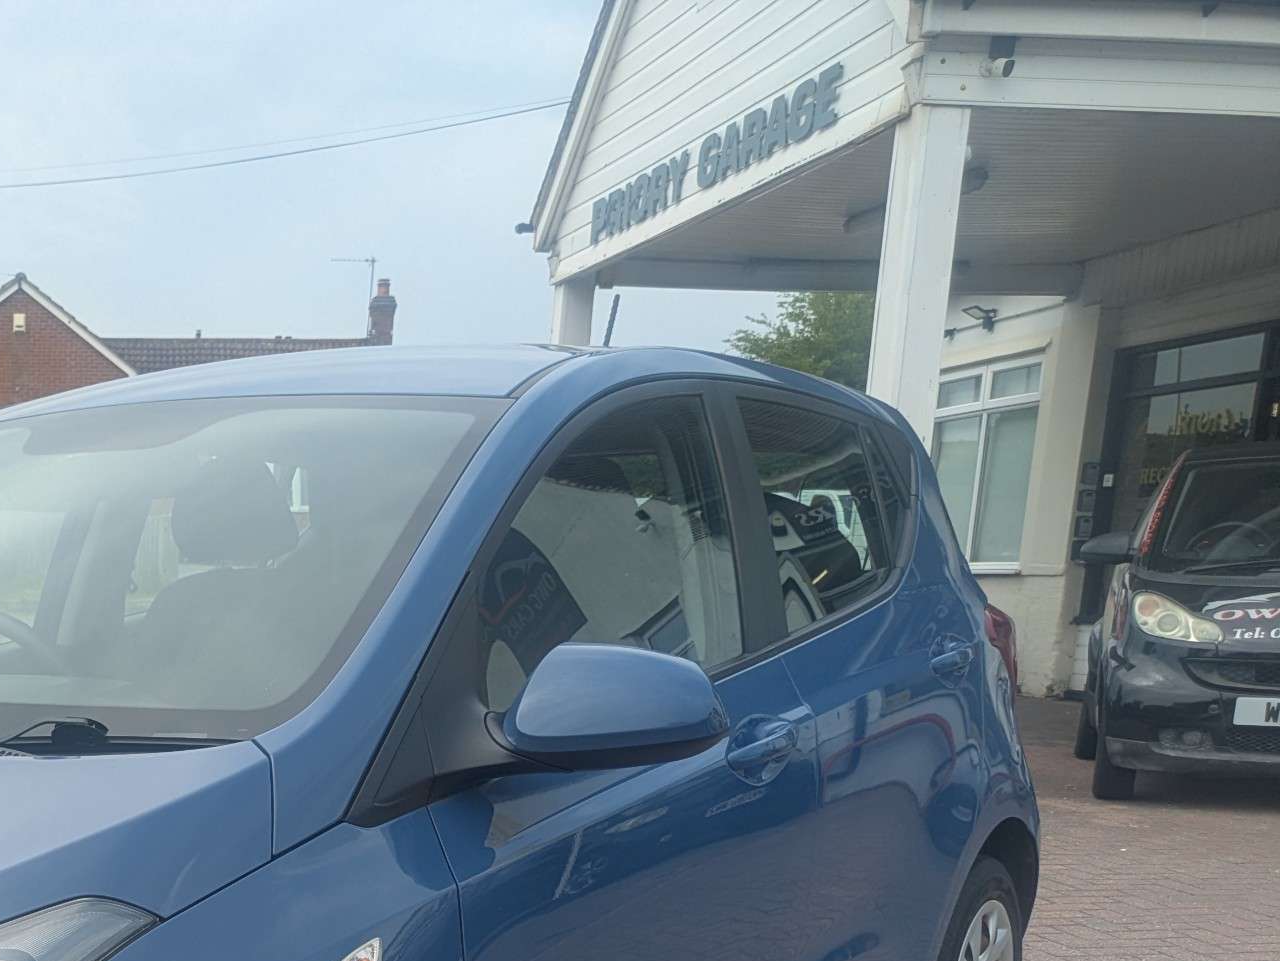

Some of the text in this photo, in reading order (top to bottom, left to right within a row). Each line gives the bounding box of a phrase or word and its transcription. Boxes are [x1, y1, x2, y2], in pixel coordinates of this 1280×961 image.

[591, 61, 844, 245] PRIORY GARAGE
[1233, 627, 1265, 639] Tel:
